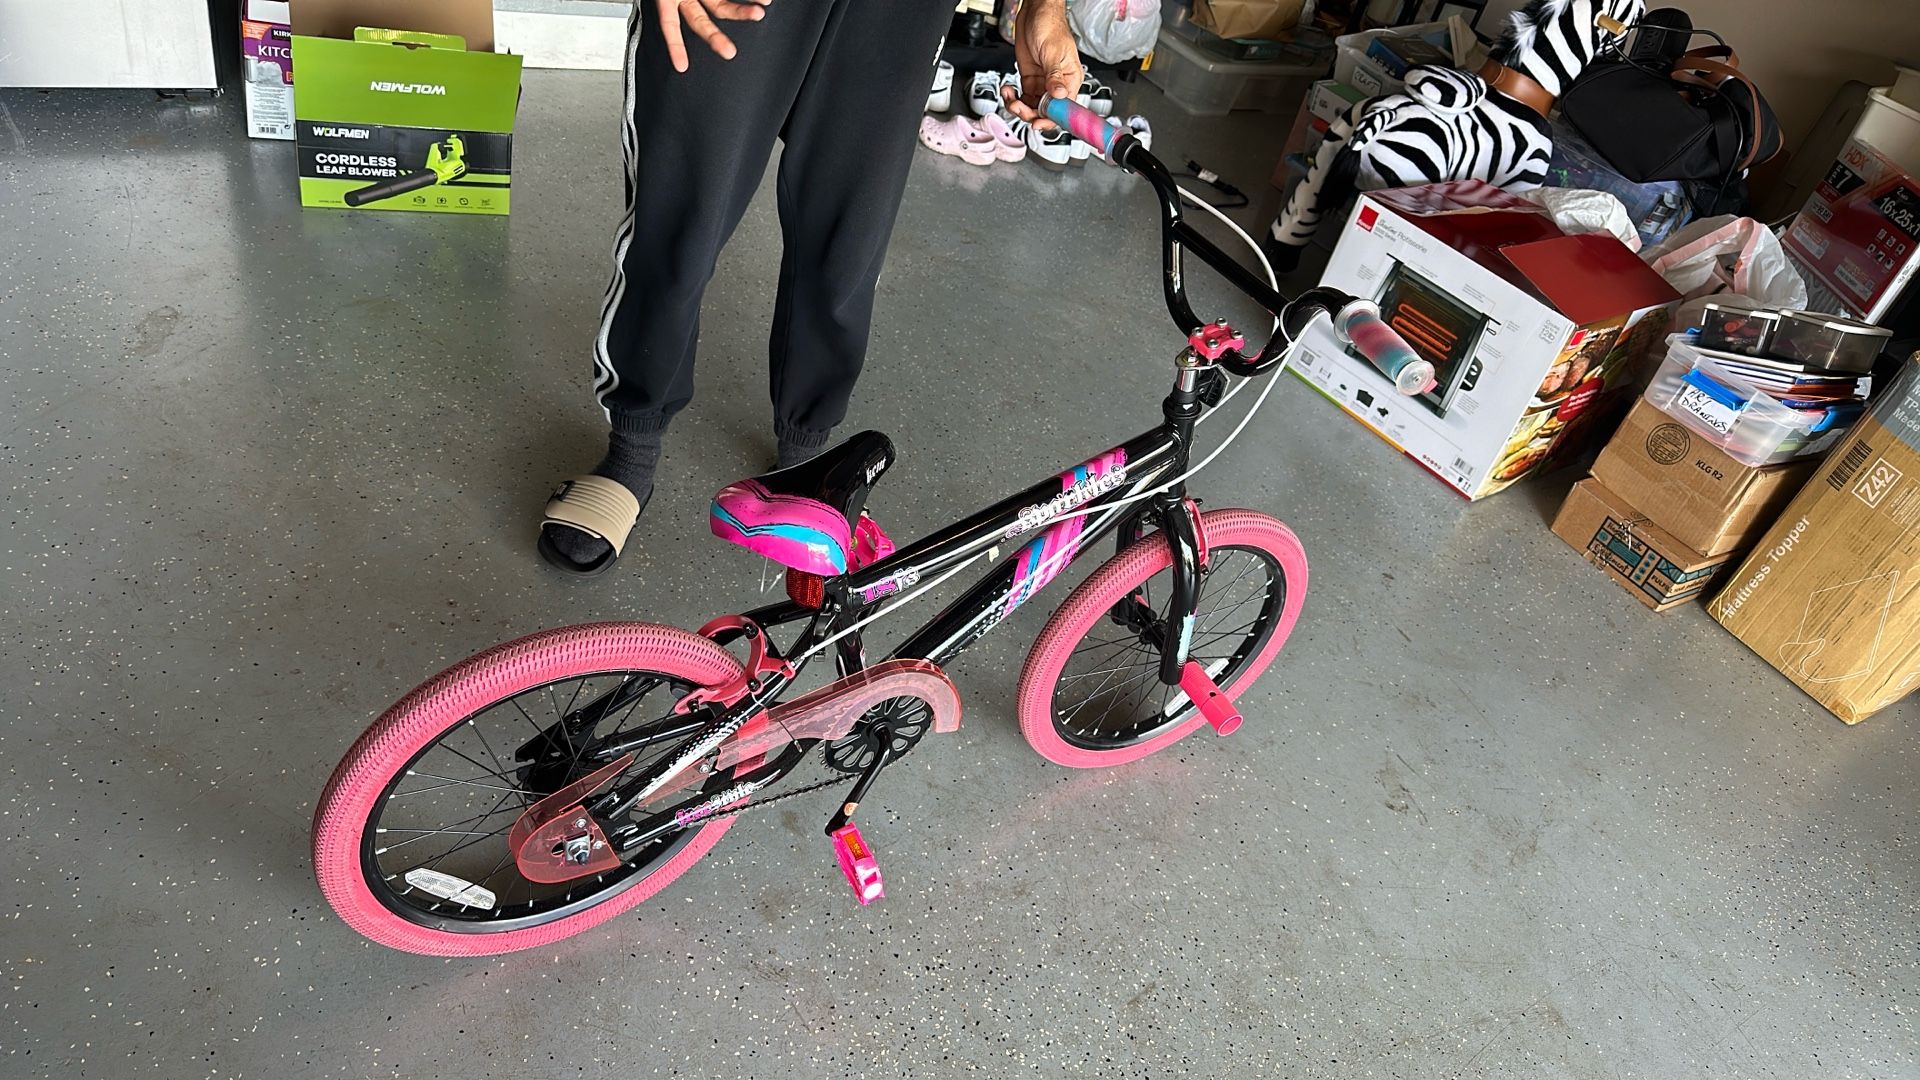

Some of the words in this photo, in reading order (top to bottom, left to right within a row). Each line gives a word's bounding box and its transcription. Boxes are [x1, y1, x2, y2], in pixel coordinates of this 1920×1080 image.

[258, 45, 293, 59] KITC
[370, 81, 446, 96] WOLFMEN
[312, 126, 370, 139] WOLFMEN
[315, 153, 397, 168] CORDLESS
[1843, 145, 1870, 172] HDX
[316, 165, 346, 175] LEAF
[348, 166, 397, 178] BLOWER
[1687, 389, 1713, 407] ART
[1681, 396, 1729, 432] DRAWINGS
[1892, 407, 1920, 432] Made
[1695, 459, 1713, 475] KLG
[1711, 468, 1724, 481] R2
[1858, 465, 1896, 504] Z42
[1721, 563, 1772, 619] Mattress
[1766, 514, 1811, 563] Topper
